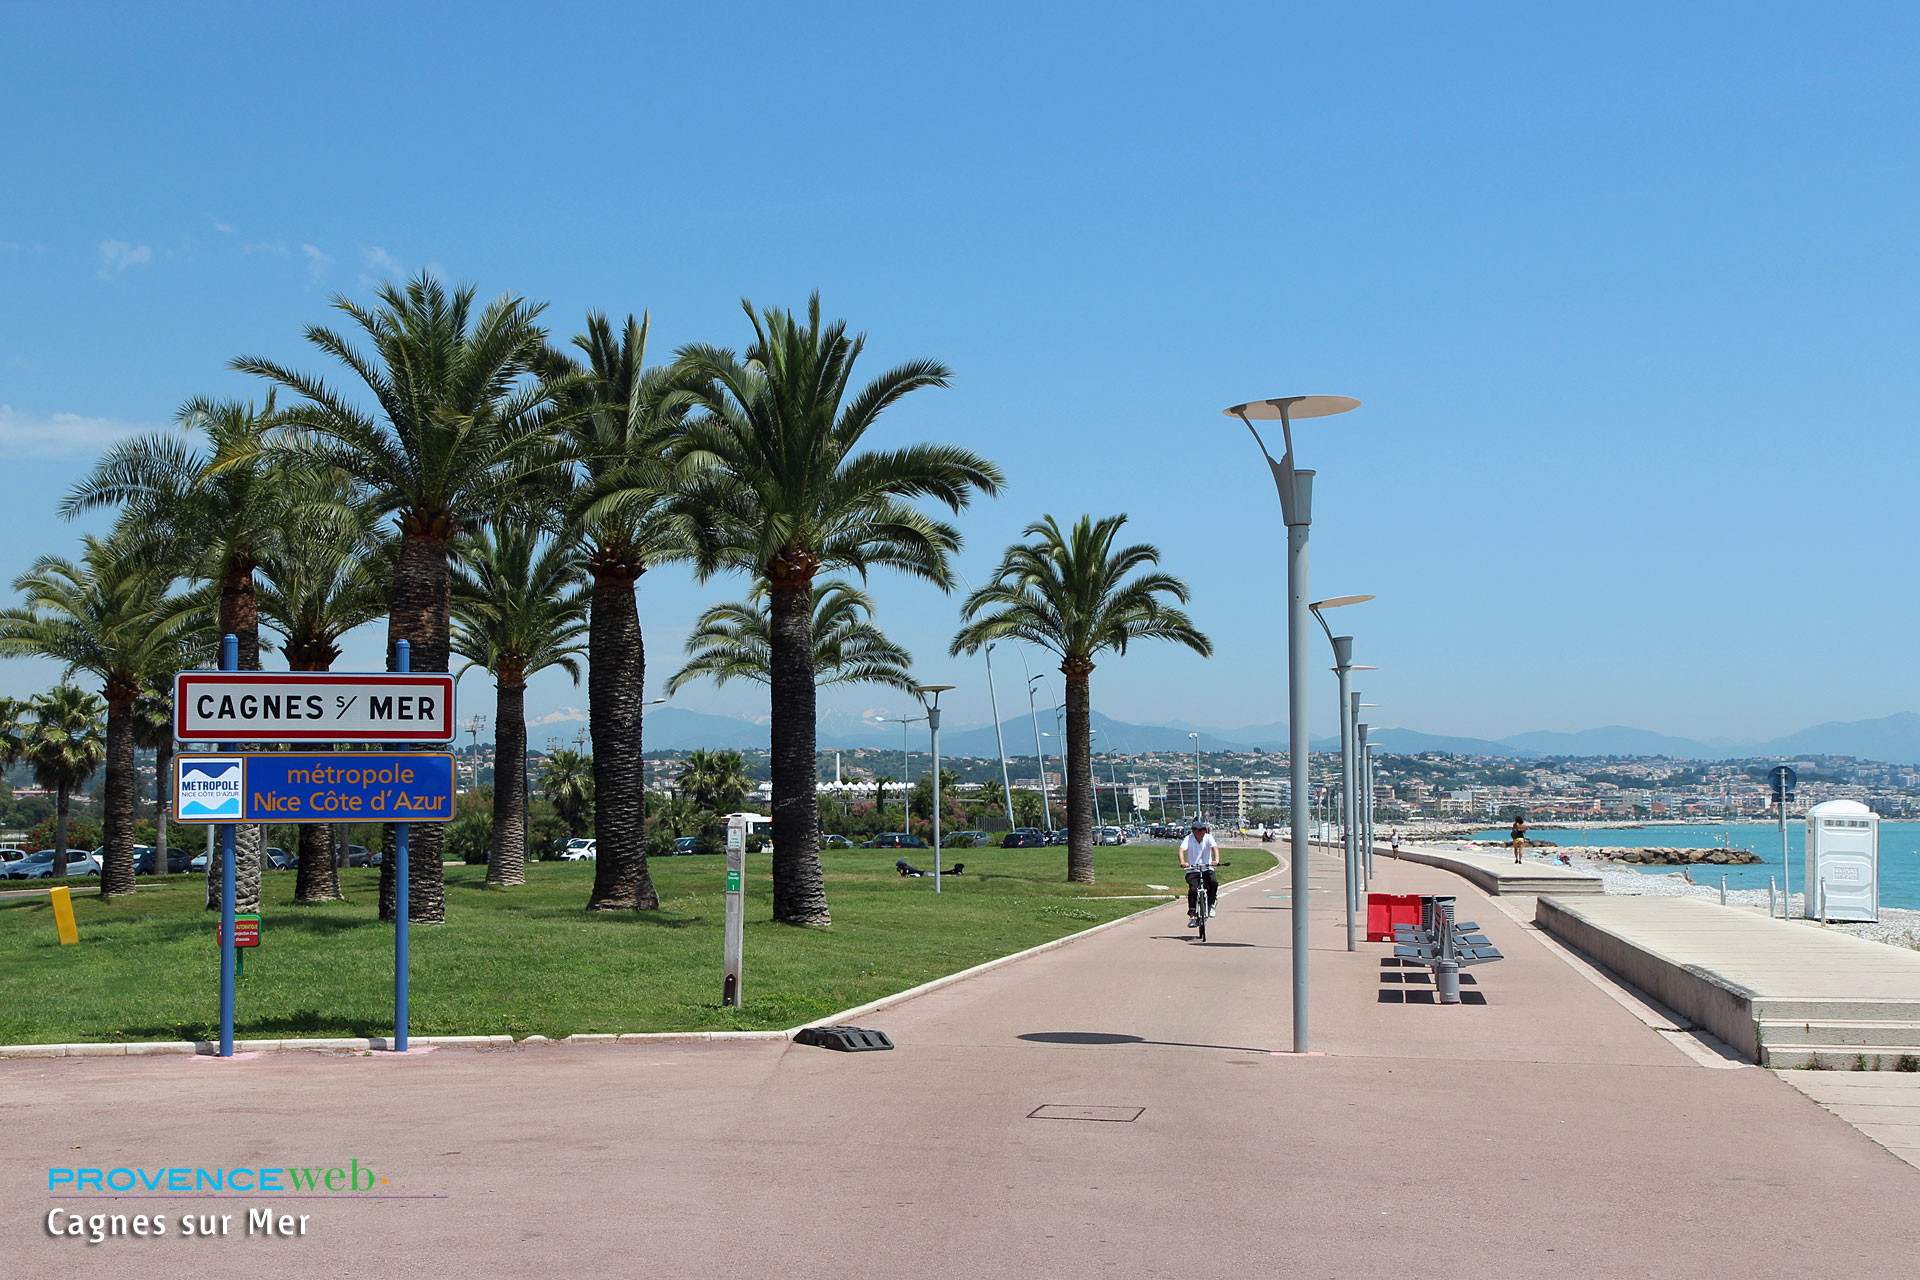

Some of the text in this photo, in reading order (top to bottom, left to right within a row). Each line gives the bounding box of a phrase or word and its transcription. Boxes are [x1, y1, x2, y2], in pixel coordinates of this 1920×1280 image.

[197, 695, 323, 720] CAGNES
[370, 696, 435, 720] MER
[182, 779, 239, 791] MÉTROPOLE
[288, 763, 415, 788] métropole
[254, 790, 447, 812] Nice Côte d'Azur
